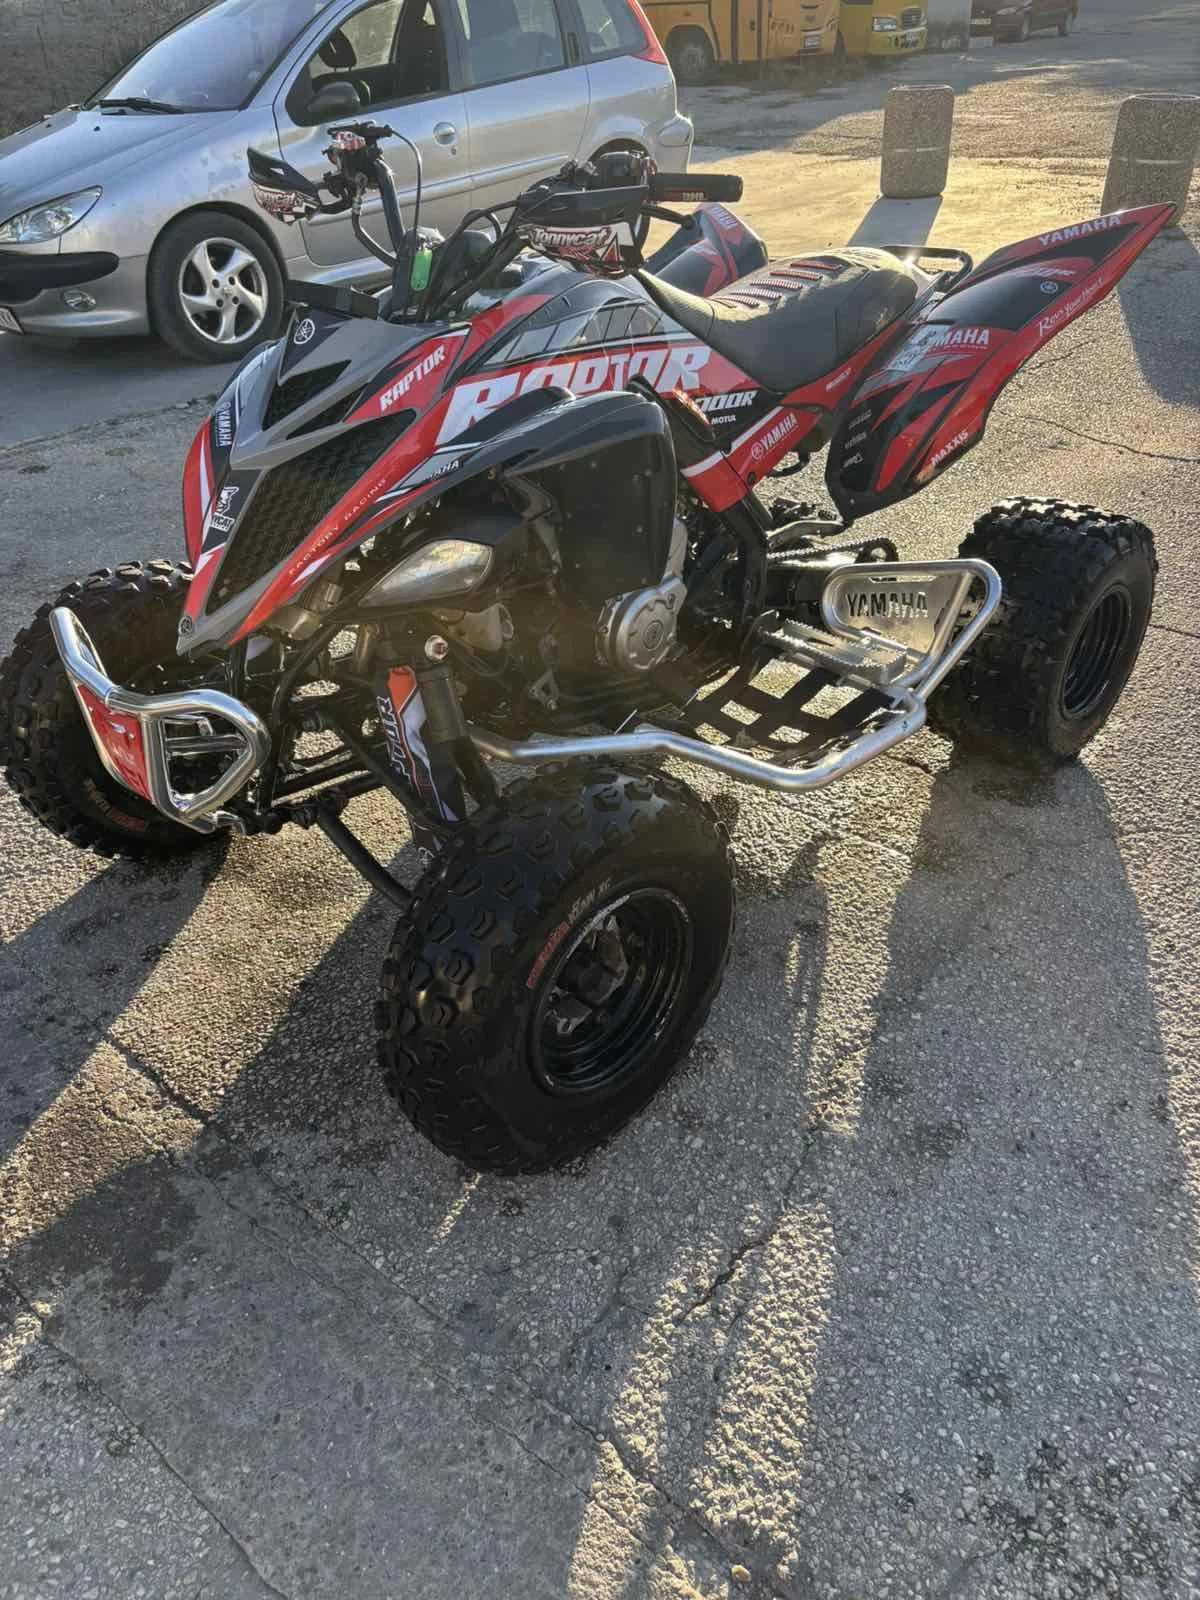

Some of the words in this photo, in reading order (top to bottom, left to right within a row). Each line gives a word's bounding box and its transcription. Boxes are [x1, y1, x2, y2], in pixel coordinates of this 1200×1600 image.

[534, 227, 608, 248] Tonnycat
[1039, 215, 1121, 246] YAMAHA
[1038, 310, 1064, 337] Rev
[379, 344, 446, 412] RAPTOR
[215, 409, 233, 447] YAMAHA
[761, 411, 798, 451] YAMAHA
[930, 430, 970, 466] MAXXIS
[288, 523, 340, 576] FACTORY
[343, 477, 388, 522] RACING
[845, 591, 929, 618] YAMAHA
